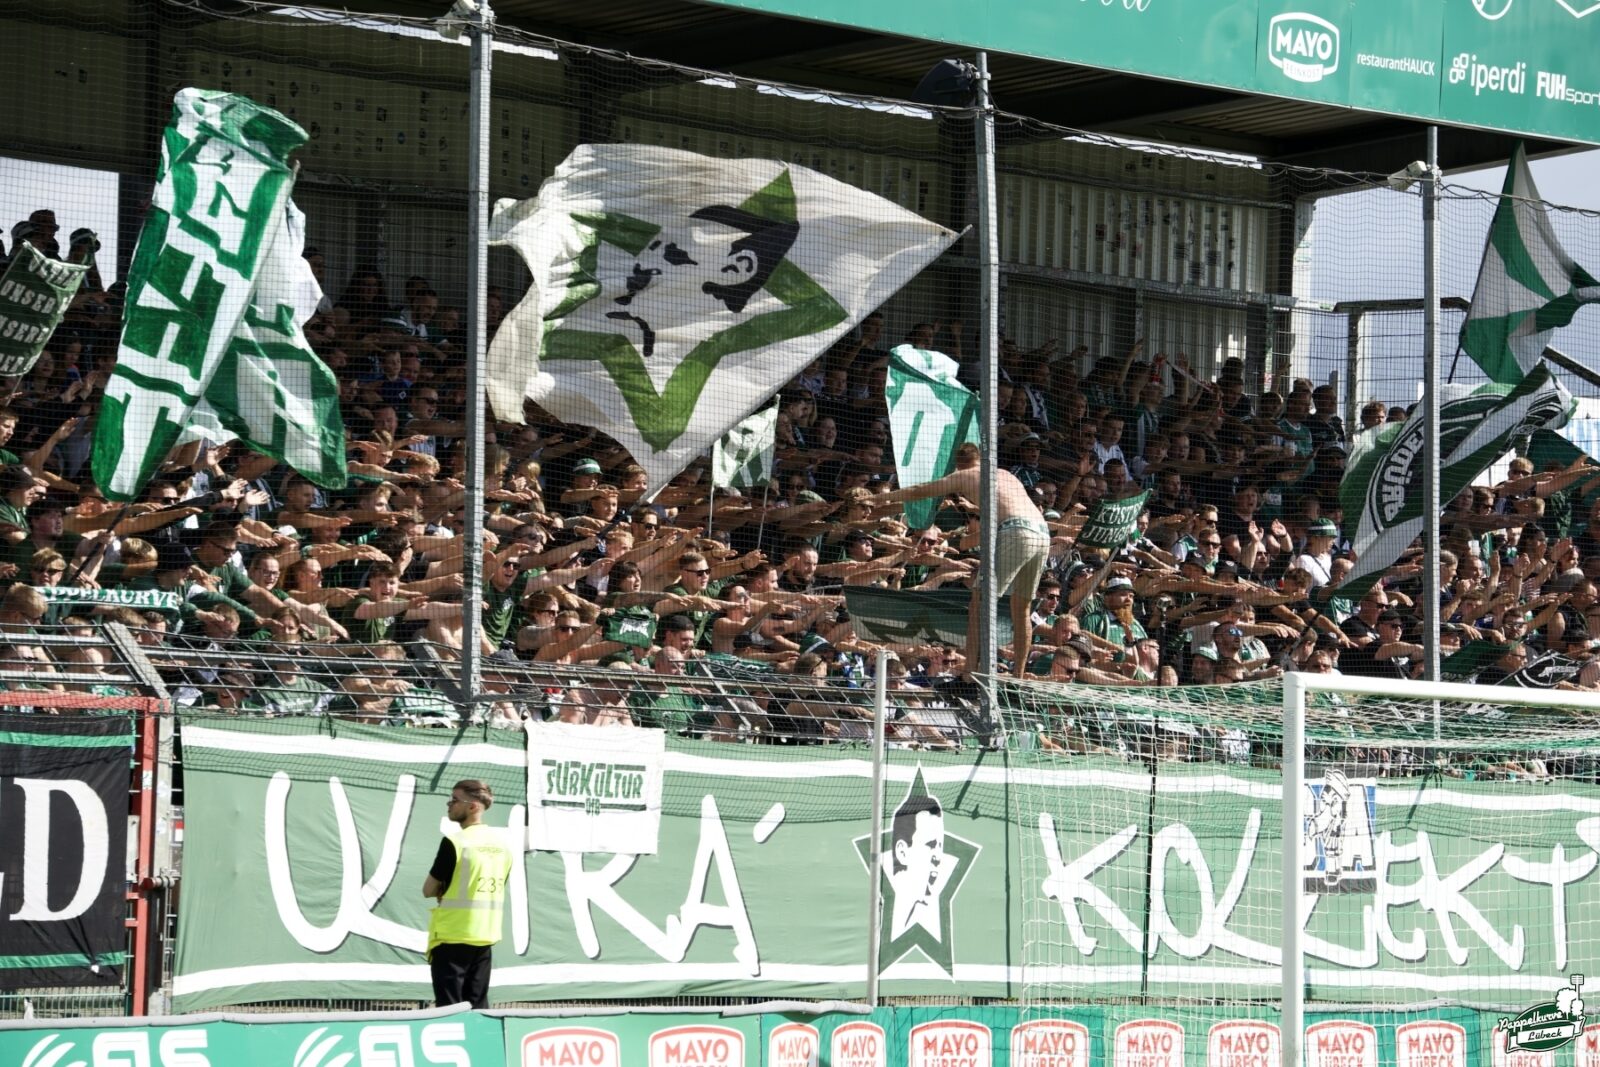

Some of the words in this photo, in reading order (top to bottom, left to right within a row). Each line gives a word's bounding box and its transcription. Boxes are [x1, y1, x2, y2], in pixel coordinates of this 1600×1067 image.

[1276, 26, 1333, 60] MAYO
[1356, 53, 1435, 76] restaurantHAUCK
[1471, 54, 1527, 96] iperdi
[0, 777, 110, 921] D
[539, 1041, 604, 1067] MAYO
[665, 1040, 729, 1064] MAYO
[778, 1036, 811, 1060] MAYO
[840, 1034, 877, 1058] MAYO
[923, 1033, 979, 1054] MAYO
[1024, 1033, 1076, 1054] MAYO
[1127, 1033, 1173, 1054] MAYO
[1219, 1033, 1270, 1054] MAYO
[1317, 1033, 1365, 1054] MAYO
[1407, 1033, 1455, 1054] MAYO
